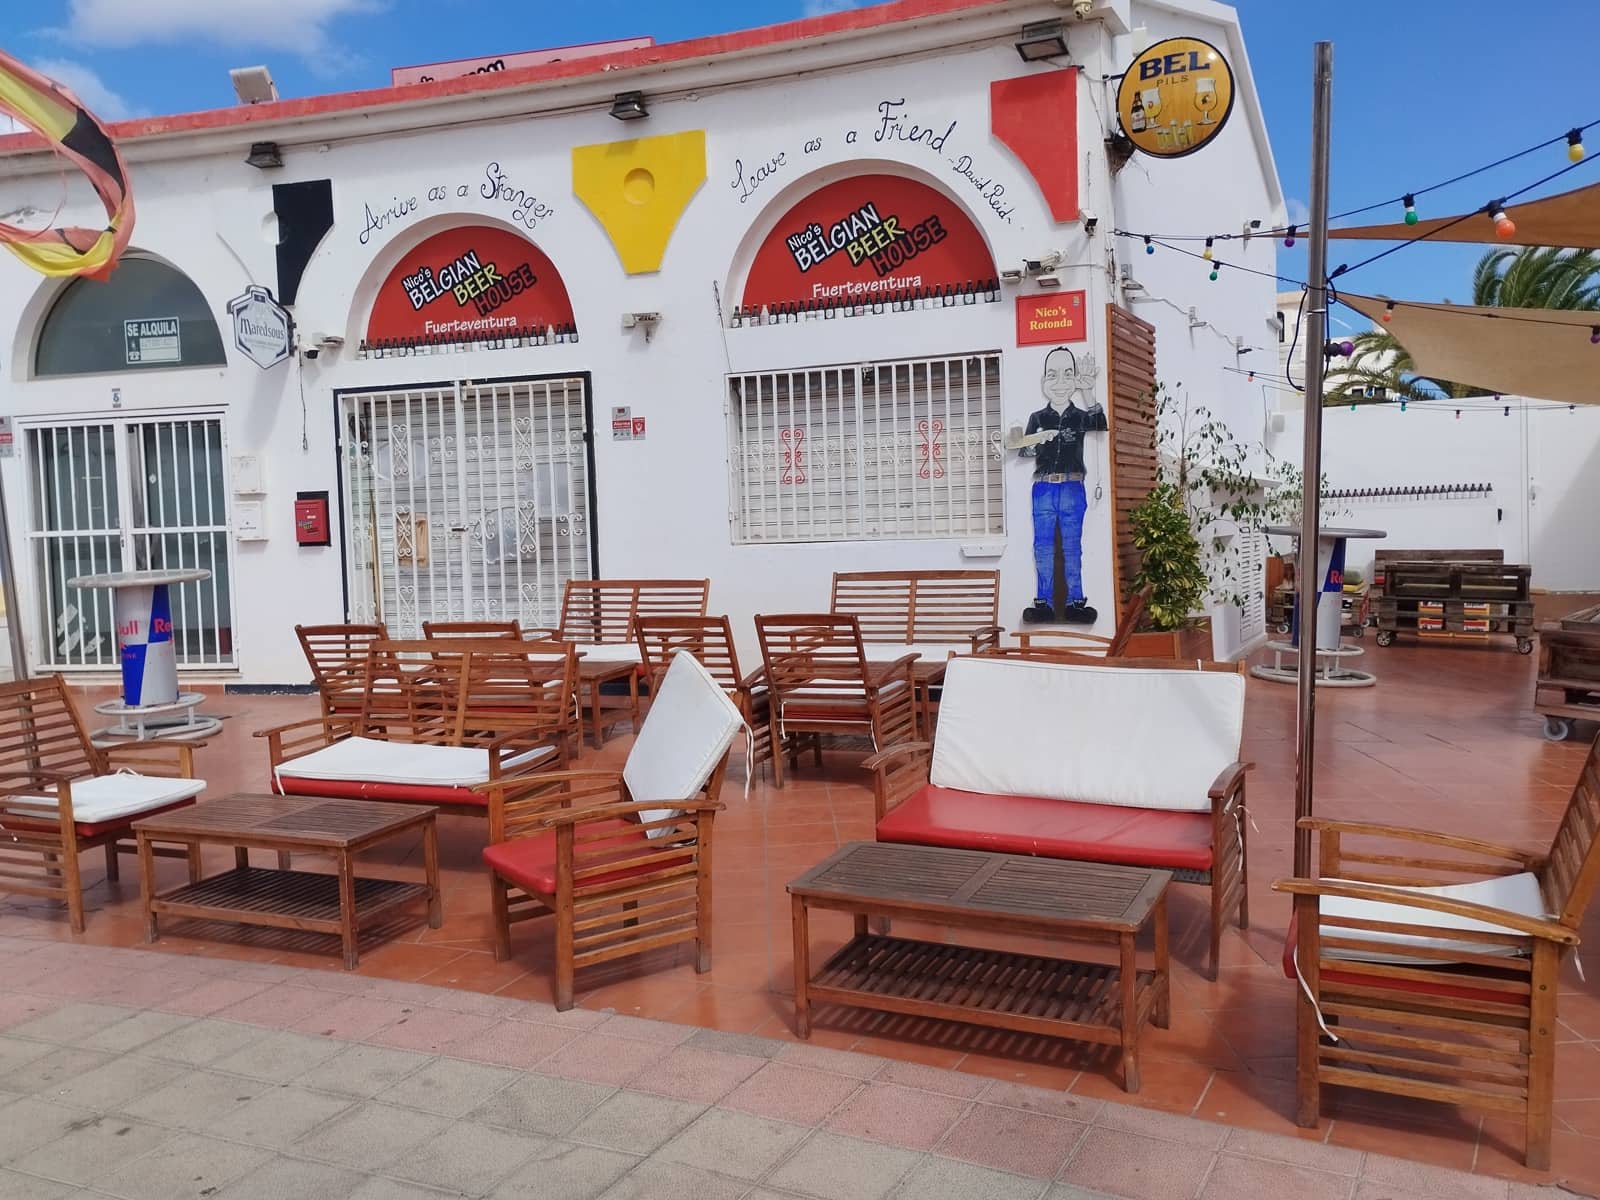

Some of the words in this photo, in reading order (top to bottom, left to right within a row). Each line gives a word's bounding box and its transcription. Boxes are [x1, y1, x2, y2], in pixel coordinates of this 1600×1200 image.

[1139, 51, 1210, 81] BEL
[1156, 75, 1190, 87] PILS
[731, 152, 787, 204] Leave
[804, 136, 822, 153] as
[846, 131, 857, 144] a
[874, 98, 957, 154] Friend
[359, 196, 418, 245] Arrive
[428, 184, 447, 201] as
[457, 184, 469, 197] a
[480, 162, 554, 229] Stranger
[788, 225, 821, 251] Nico's
[794, 204, 881, 272] BELGIAN
[846, 218, 905, 266] BEER
[870, 215, 948, 277] HOUSE
[403, 267, 432, 291] Nico's
[409, 251, 481, 309] BELGIAN
[453, 264, 502, 305] BEER
[474, 265, 536, 315] HOUSE
[812, 275, 922, 298] Fuerteventura
[425, 316, 517, 334] Fuerteventura
[1030, 318, 1073, 331] Rotonda
[1035, 306, 1067, 318] Nico's
[127, 323, 139, 337] SE
[140, 320, 177, 337] ALQUILA
[240, 318, 284, 339] Maredsous
[154, 618, 172, 634] Re
